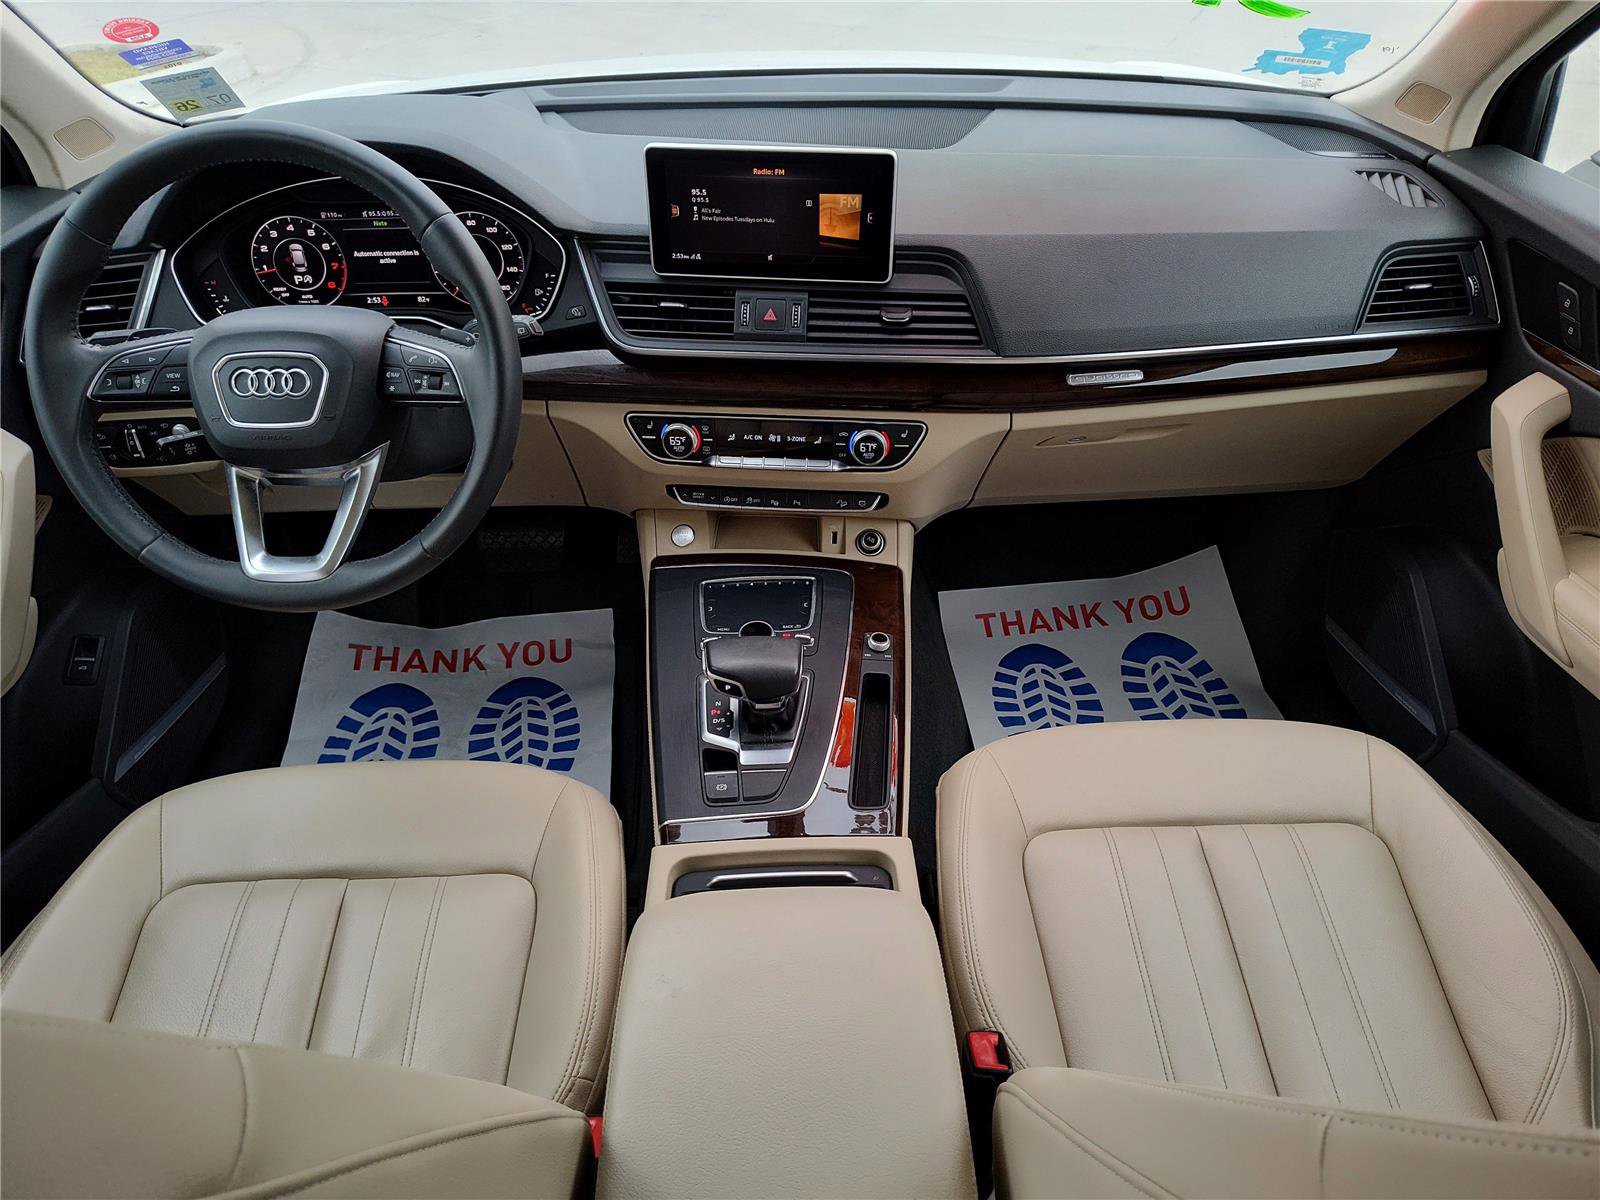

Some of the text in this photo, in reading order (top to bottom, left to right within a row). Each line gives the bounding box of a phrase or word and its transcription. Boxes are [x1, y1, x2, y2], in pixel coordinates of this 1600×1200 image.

[840, 196, 859, 209] FM
[734, 216, 756, 224] Tuesdays
[383, 249, 413, 257] connection
[331, 262, 339, 270] 7
[293, 275, 303, 284] P
[974, 585, 1191, 638] THANK YOU
[348, 638, 573, 674] THANK YOU
